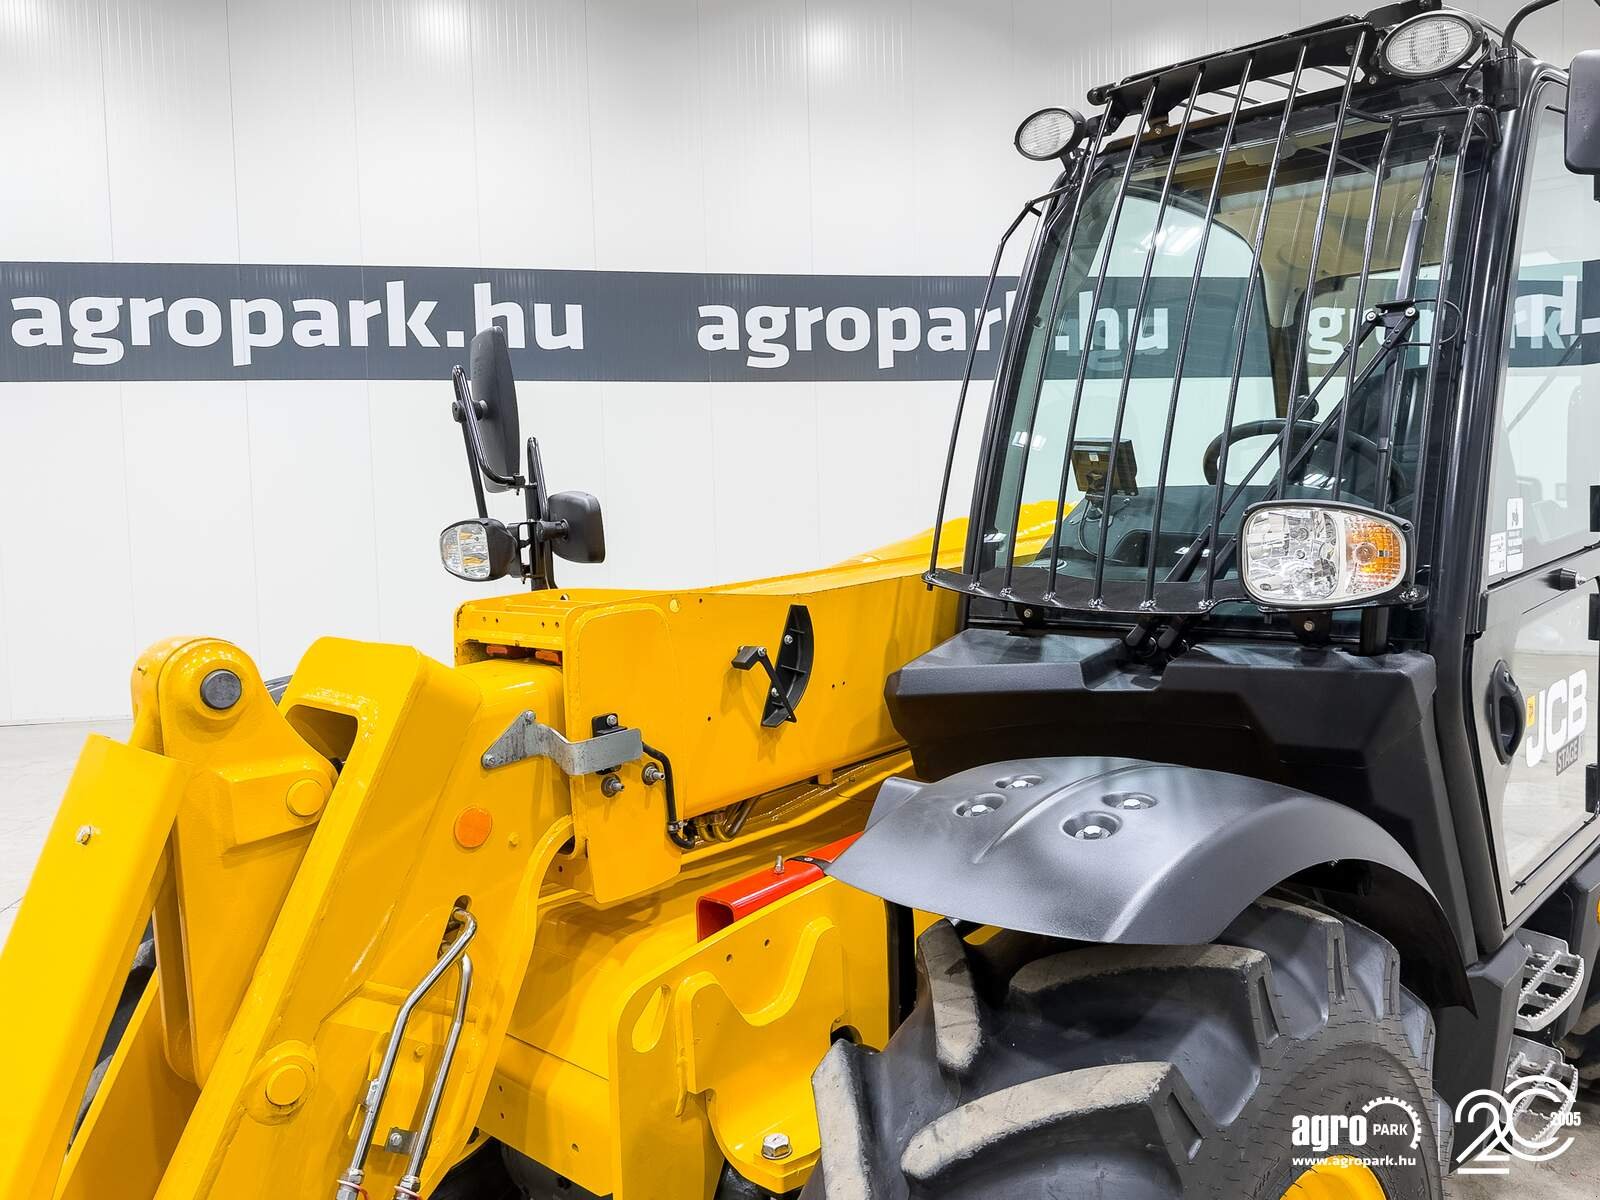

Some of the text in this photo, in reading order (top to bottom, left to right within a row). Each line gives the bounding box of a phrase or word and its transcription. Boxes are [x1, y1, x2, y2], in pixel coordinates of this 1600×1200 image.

[11, 281, 584, 366] agropark.hu
[697, 291, 1169, 369] agropar.hu
[1526, 669, 1587, 768] JCB
